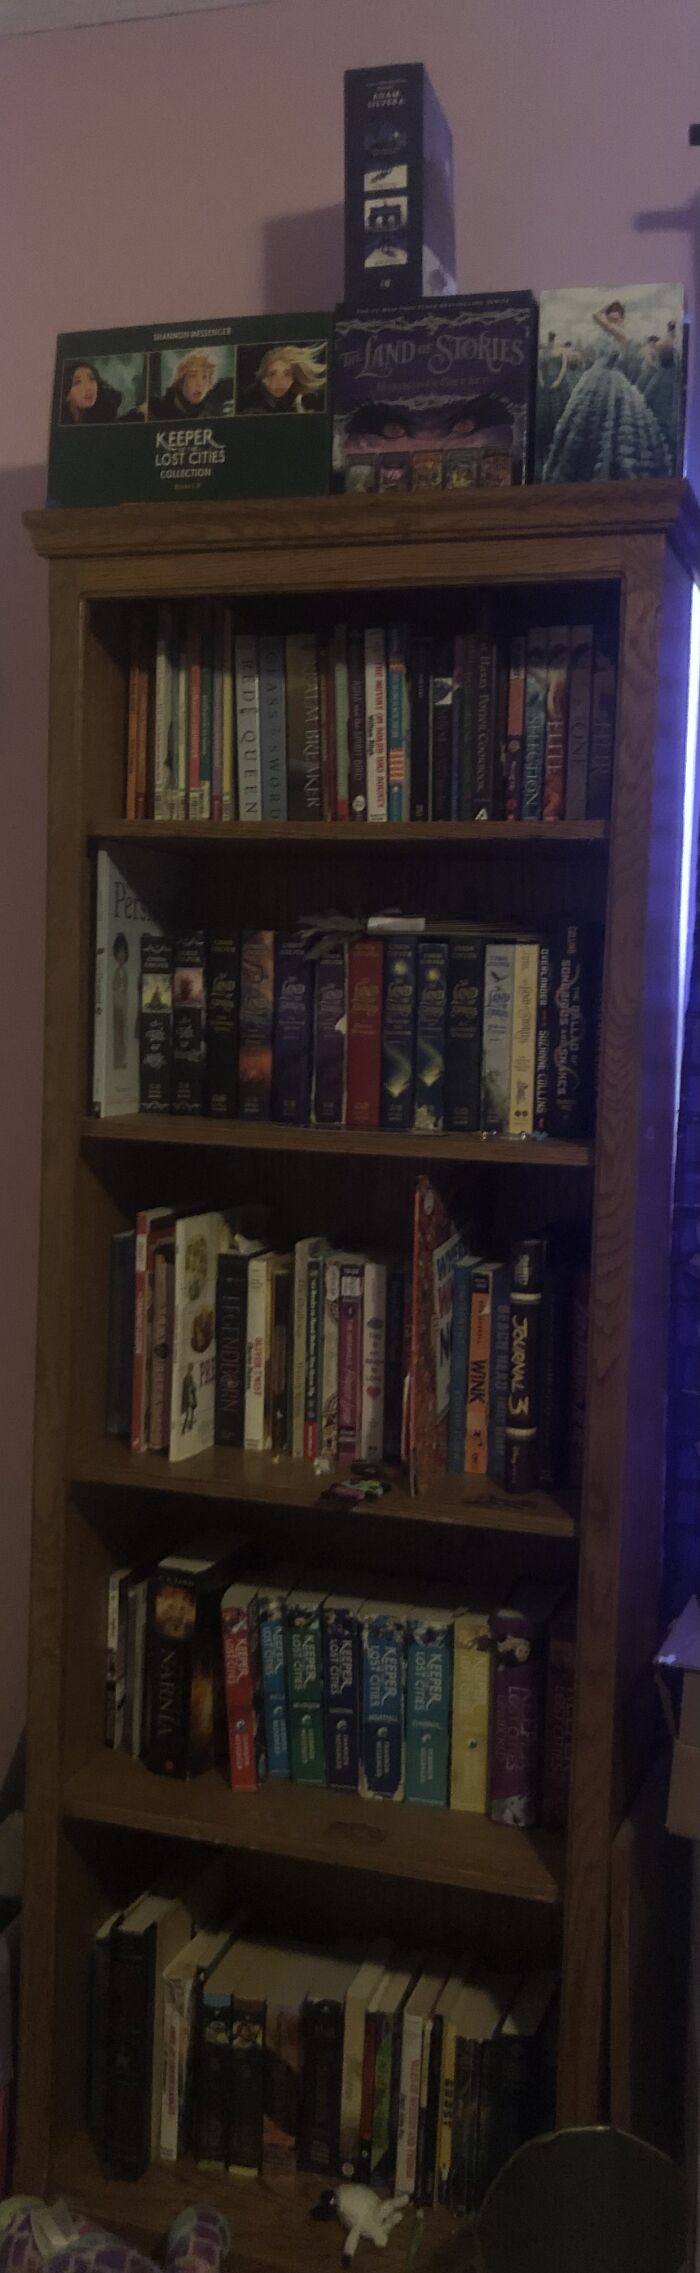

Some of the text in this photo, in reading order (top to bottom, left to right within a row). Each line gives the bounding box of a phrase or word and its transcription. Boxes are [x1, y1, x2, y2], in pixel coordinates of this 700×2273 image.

[355, 335, 416, 379] LAND
[427, 331, 526, 374] STORIES
[155, 449, 226, 467] LOST CITIES
[156, 428, 226, 451] KEEPER
[160, 468, 212, 479] COLLECTION
[242, 731, 258, 815] QUEEN
[303, 729, 320, 808] BREAKER
[524, 714, 540, 808] SELECTION
[547, 721, 564, 771] ELITE
[539, 948, 549, 1006] OVERLANDER
[570, 1005, 580, 1052] BALLAD
[536, 1030, 549, 1114] SUZANNE COLLINS
[220, 1295, 241, 1412] LEGENDBORN
[469, 1360, 486, 1403] WINK
[508, 1314, 530, 1416] JOURNAL 3
[292, 1634, 303, 1690] LOST CITIES
[302, 1634, 317, 1689] KEEPER
[329, 1639, 341, 1695] LOST CITIES
[338, 1640, 353, 1695] KEEPER
[369, 1645, 381, 1707] LOST CITIES
[381, 1646, 398, 1707] KEEPER
[414, 1651, 426, 1711] LOST CITIES
[425, 1654, 443, 1710] KEEPER
[156, 1647, 177, 1737] NARNIA
